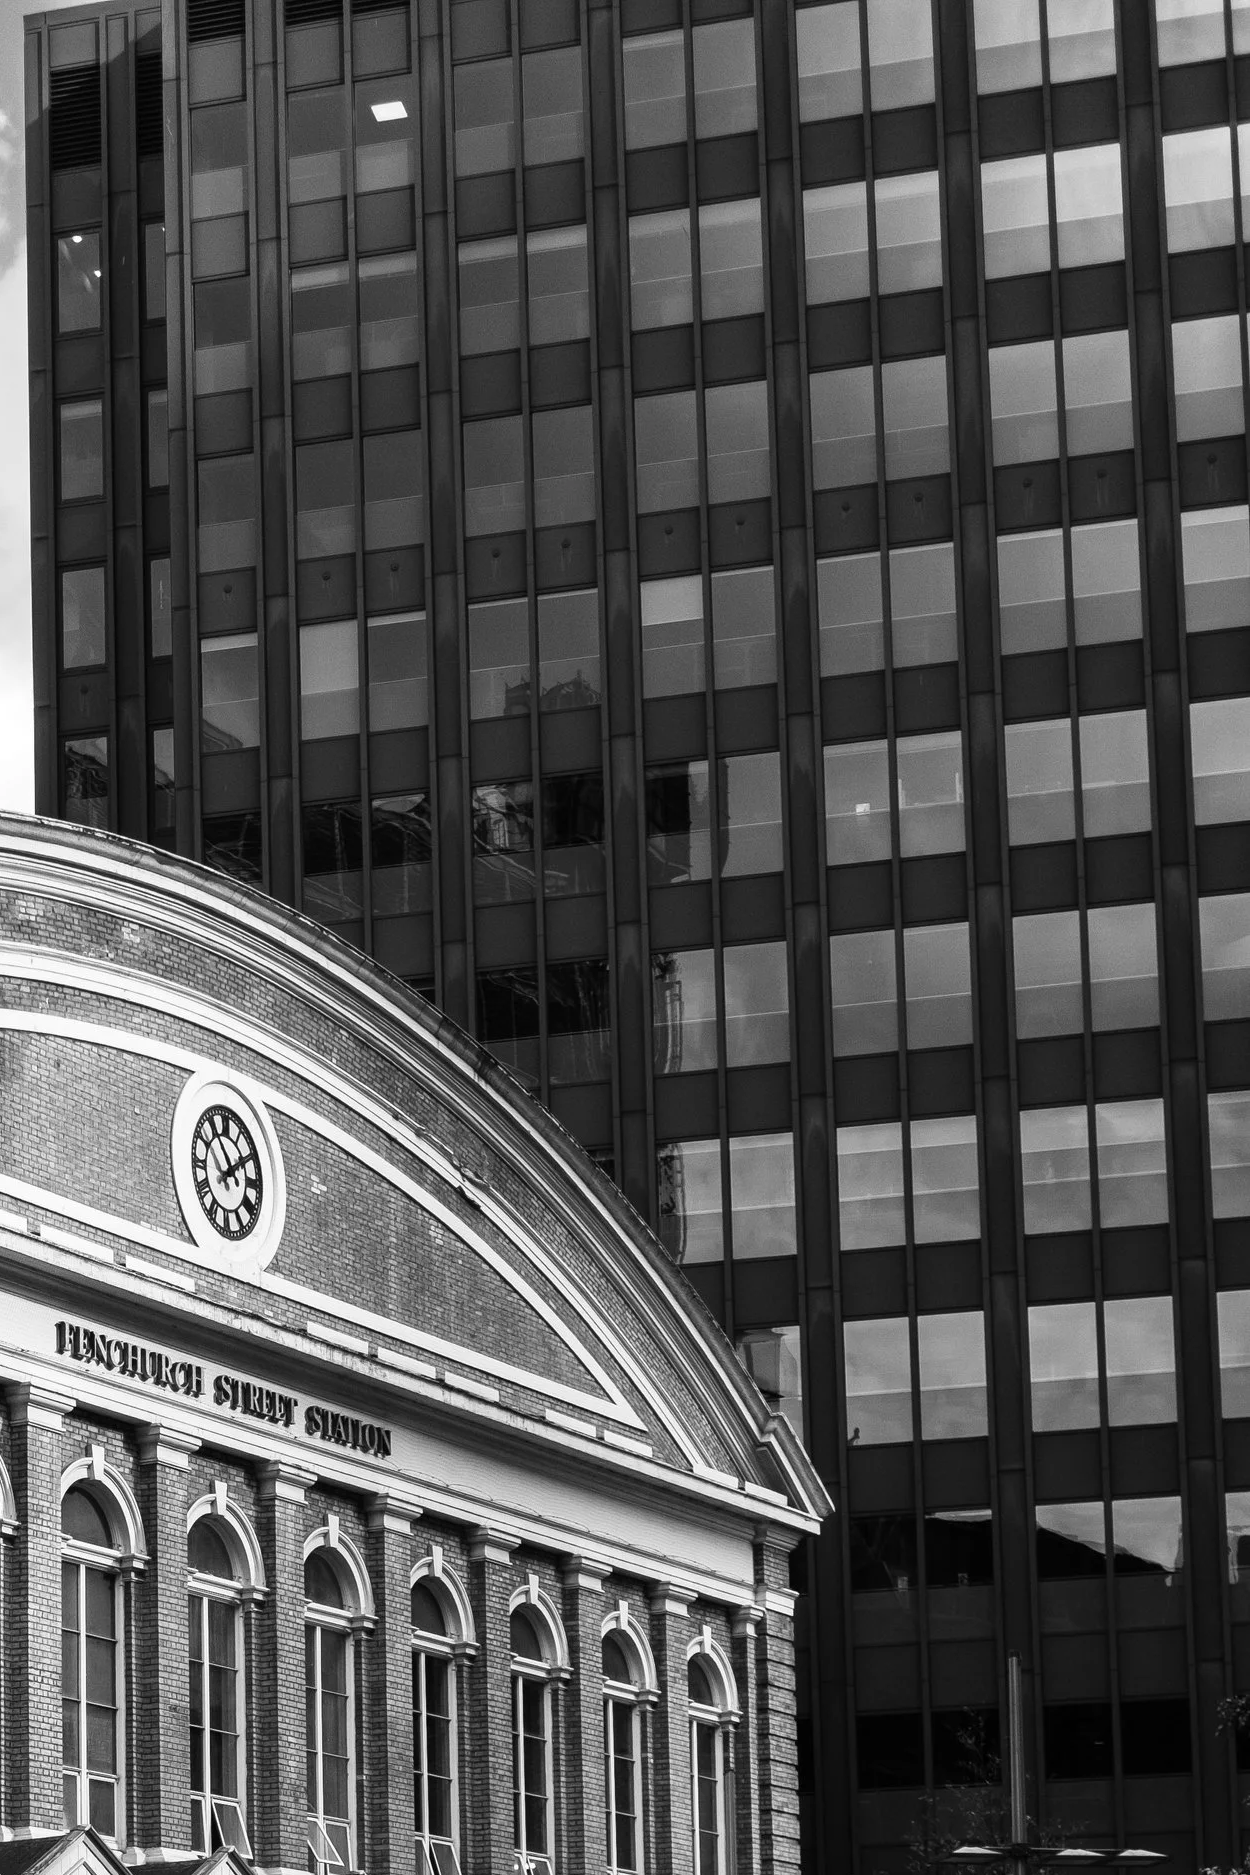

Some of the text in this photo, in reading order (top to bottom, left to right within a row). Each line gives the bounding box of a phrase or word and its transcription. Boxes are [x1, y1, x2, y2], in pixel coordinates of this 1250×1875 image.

[54, 1320, 392, 1458] FENCHURCH STREET STATION
